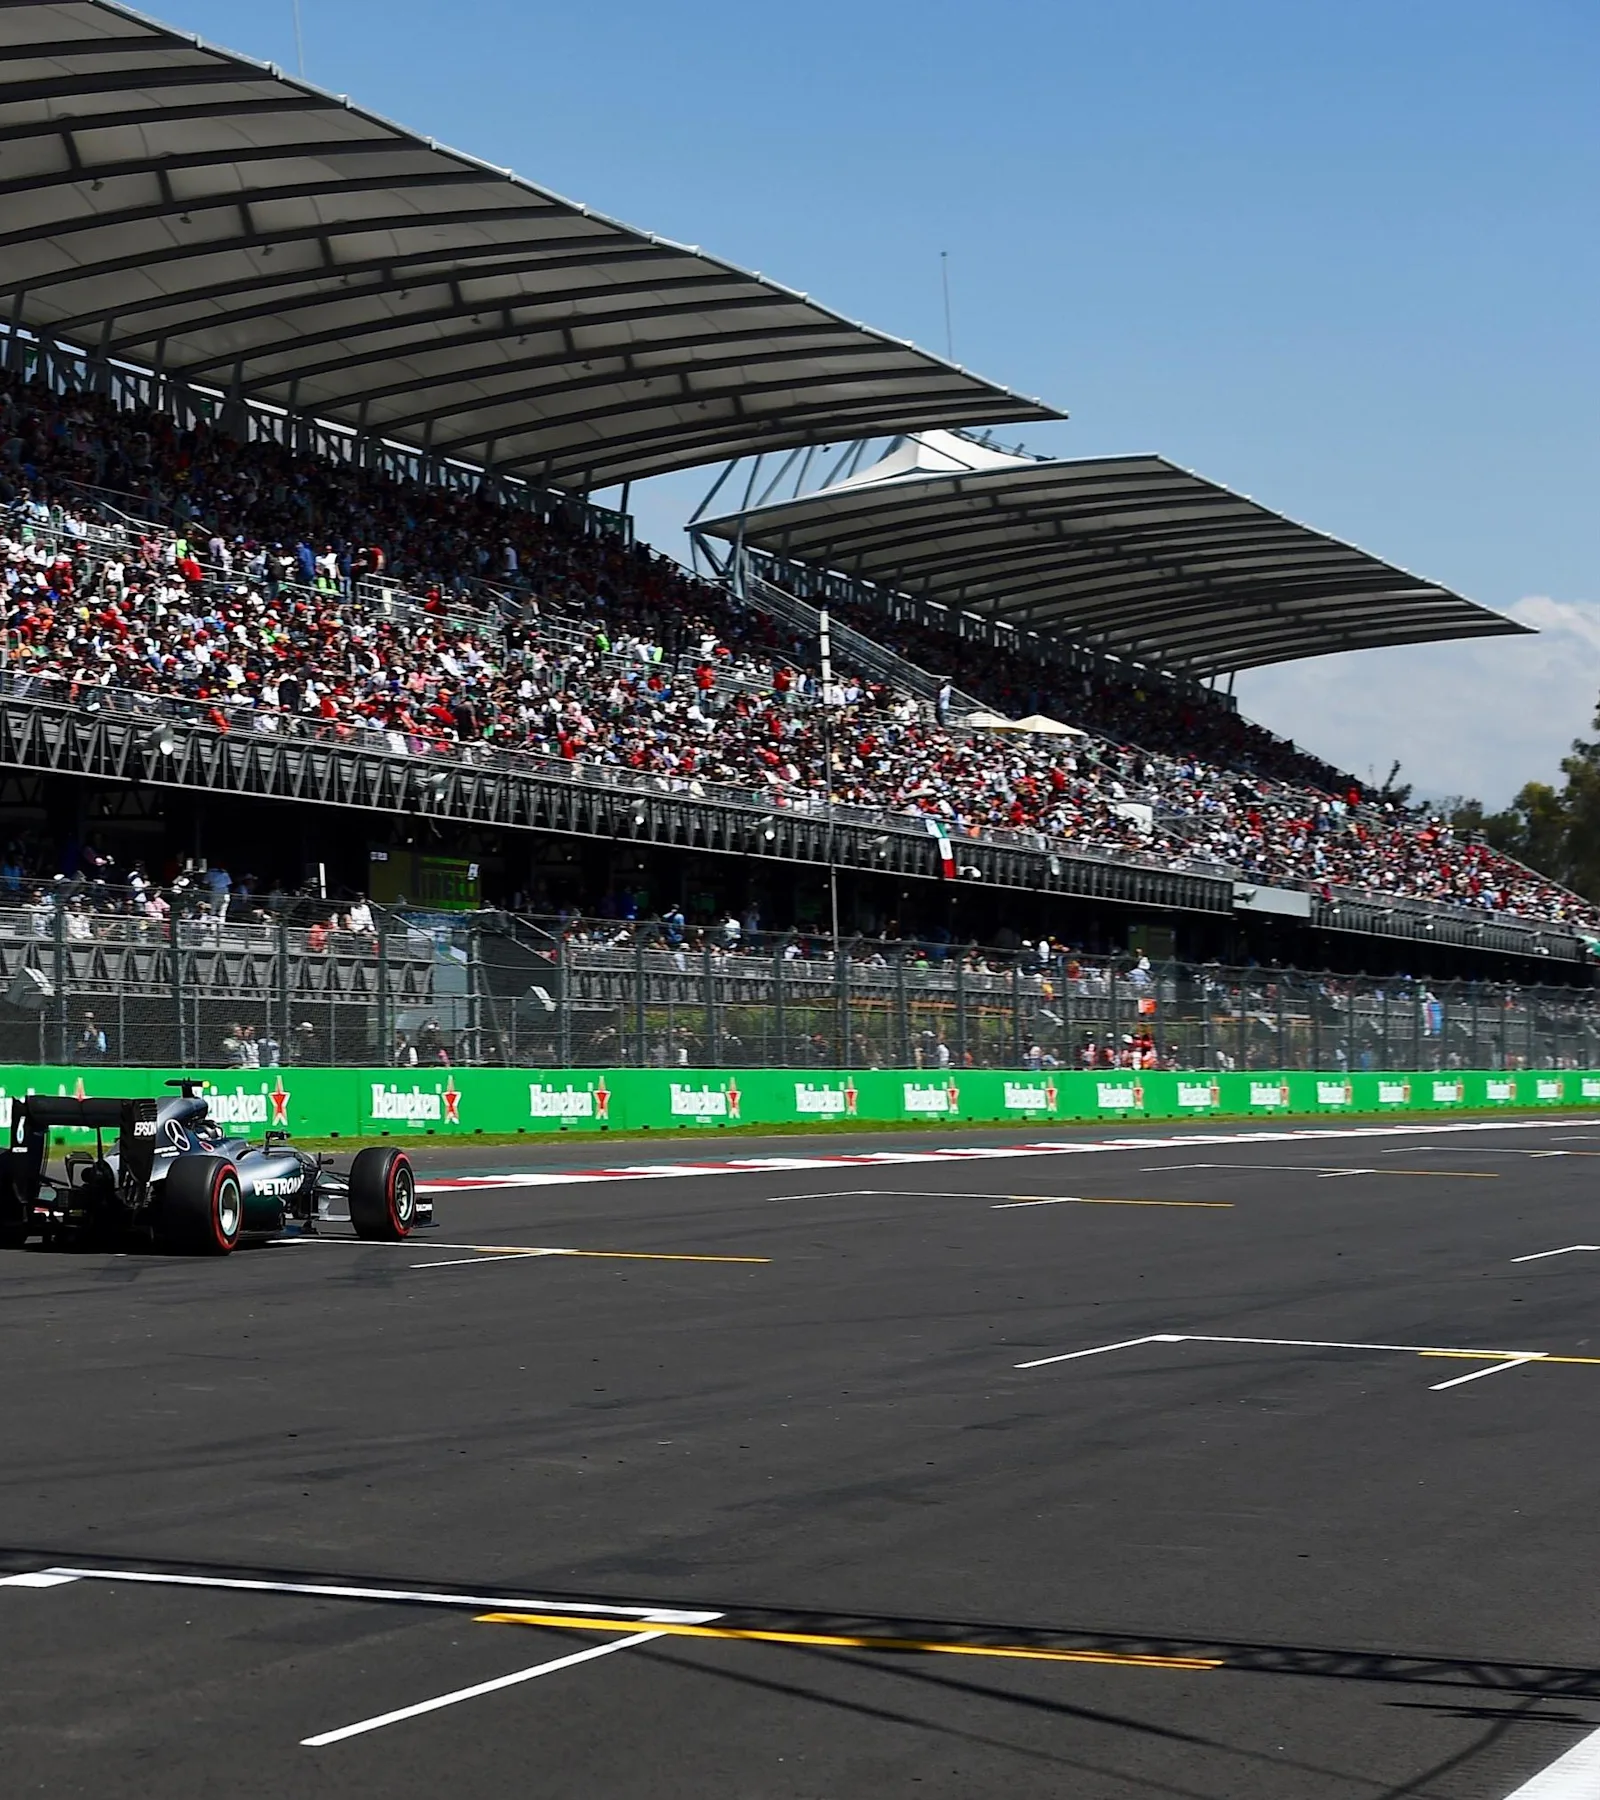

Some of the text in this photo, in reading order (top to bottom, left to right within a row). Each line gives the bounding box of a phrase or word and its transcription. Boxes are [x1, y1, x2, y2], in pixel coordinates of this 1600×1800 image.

[371, 1083, 441, 1119] Heineken
[529, 1083, 593, 1117] Heineken
[670, 1083, 727, 1116] Heineken
[16, 1116, 25, 1144] 6
[134, 1121, 157, 1136] EPSON
